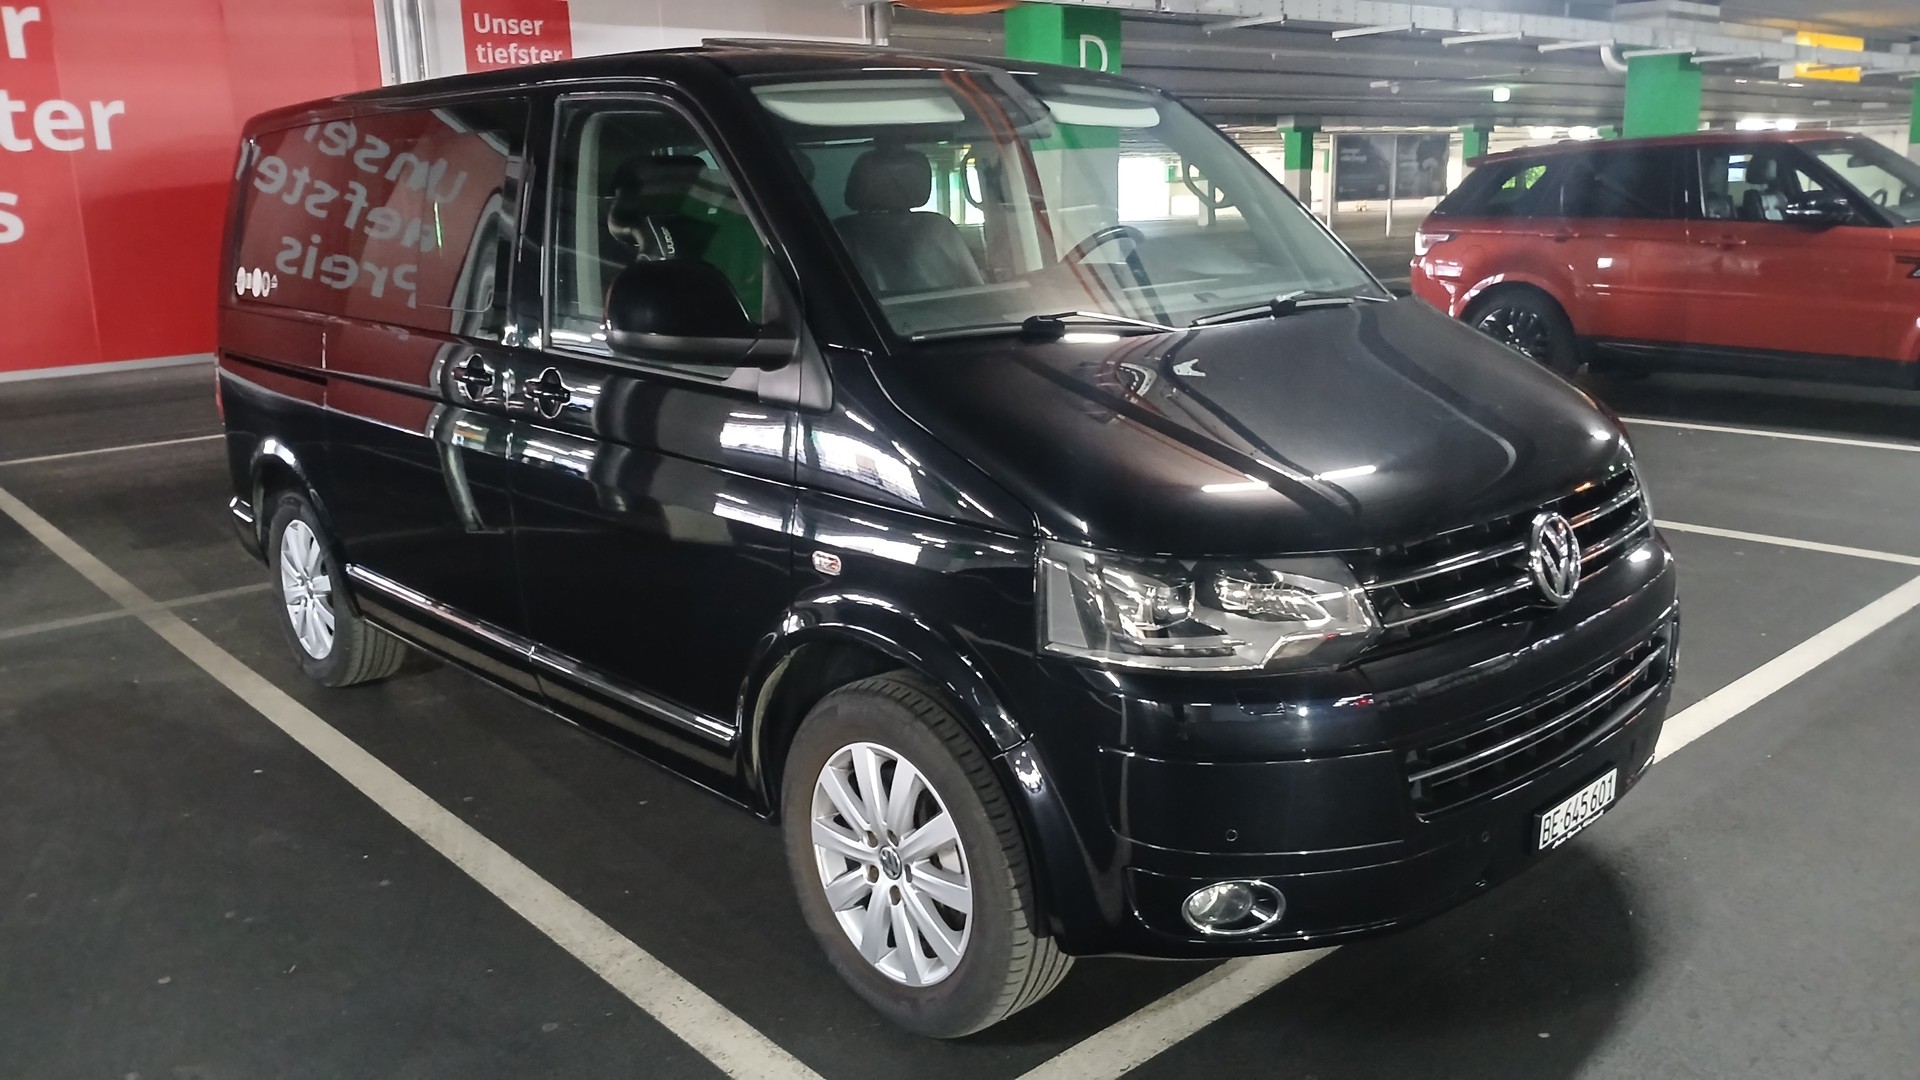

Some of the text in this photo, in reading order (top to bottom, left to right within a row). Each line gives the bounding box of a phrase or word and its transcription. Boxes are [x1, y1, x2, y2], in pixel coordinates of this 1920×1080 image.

[473, 12, 544, 36] Unser
[475, 42, 563, 65] tiefster
[1080, 34, 1108, 72] D
